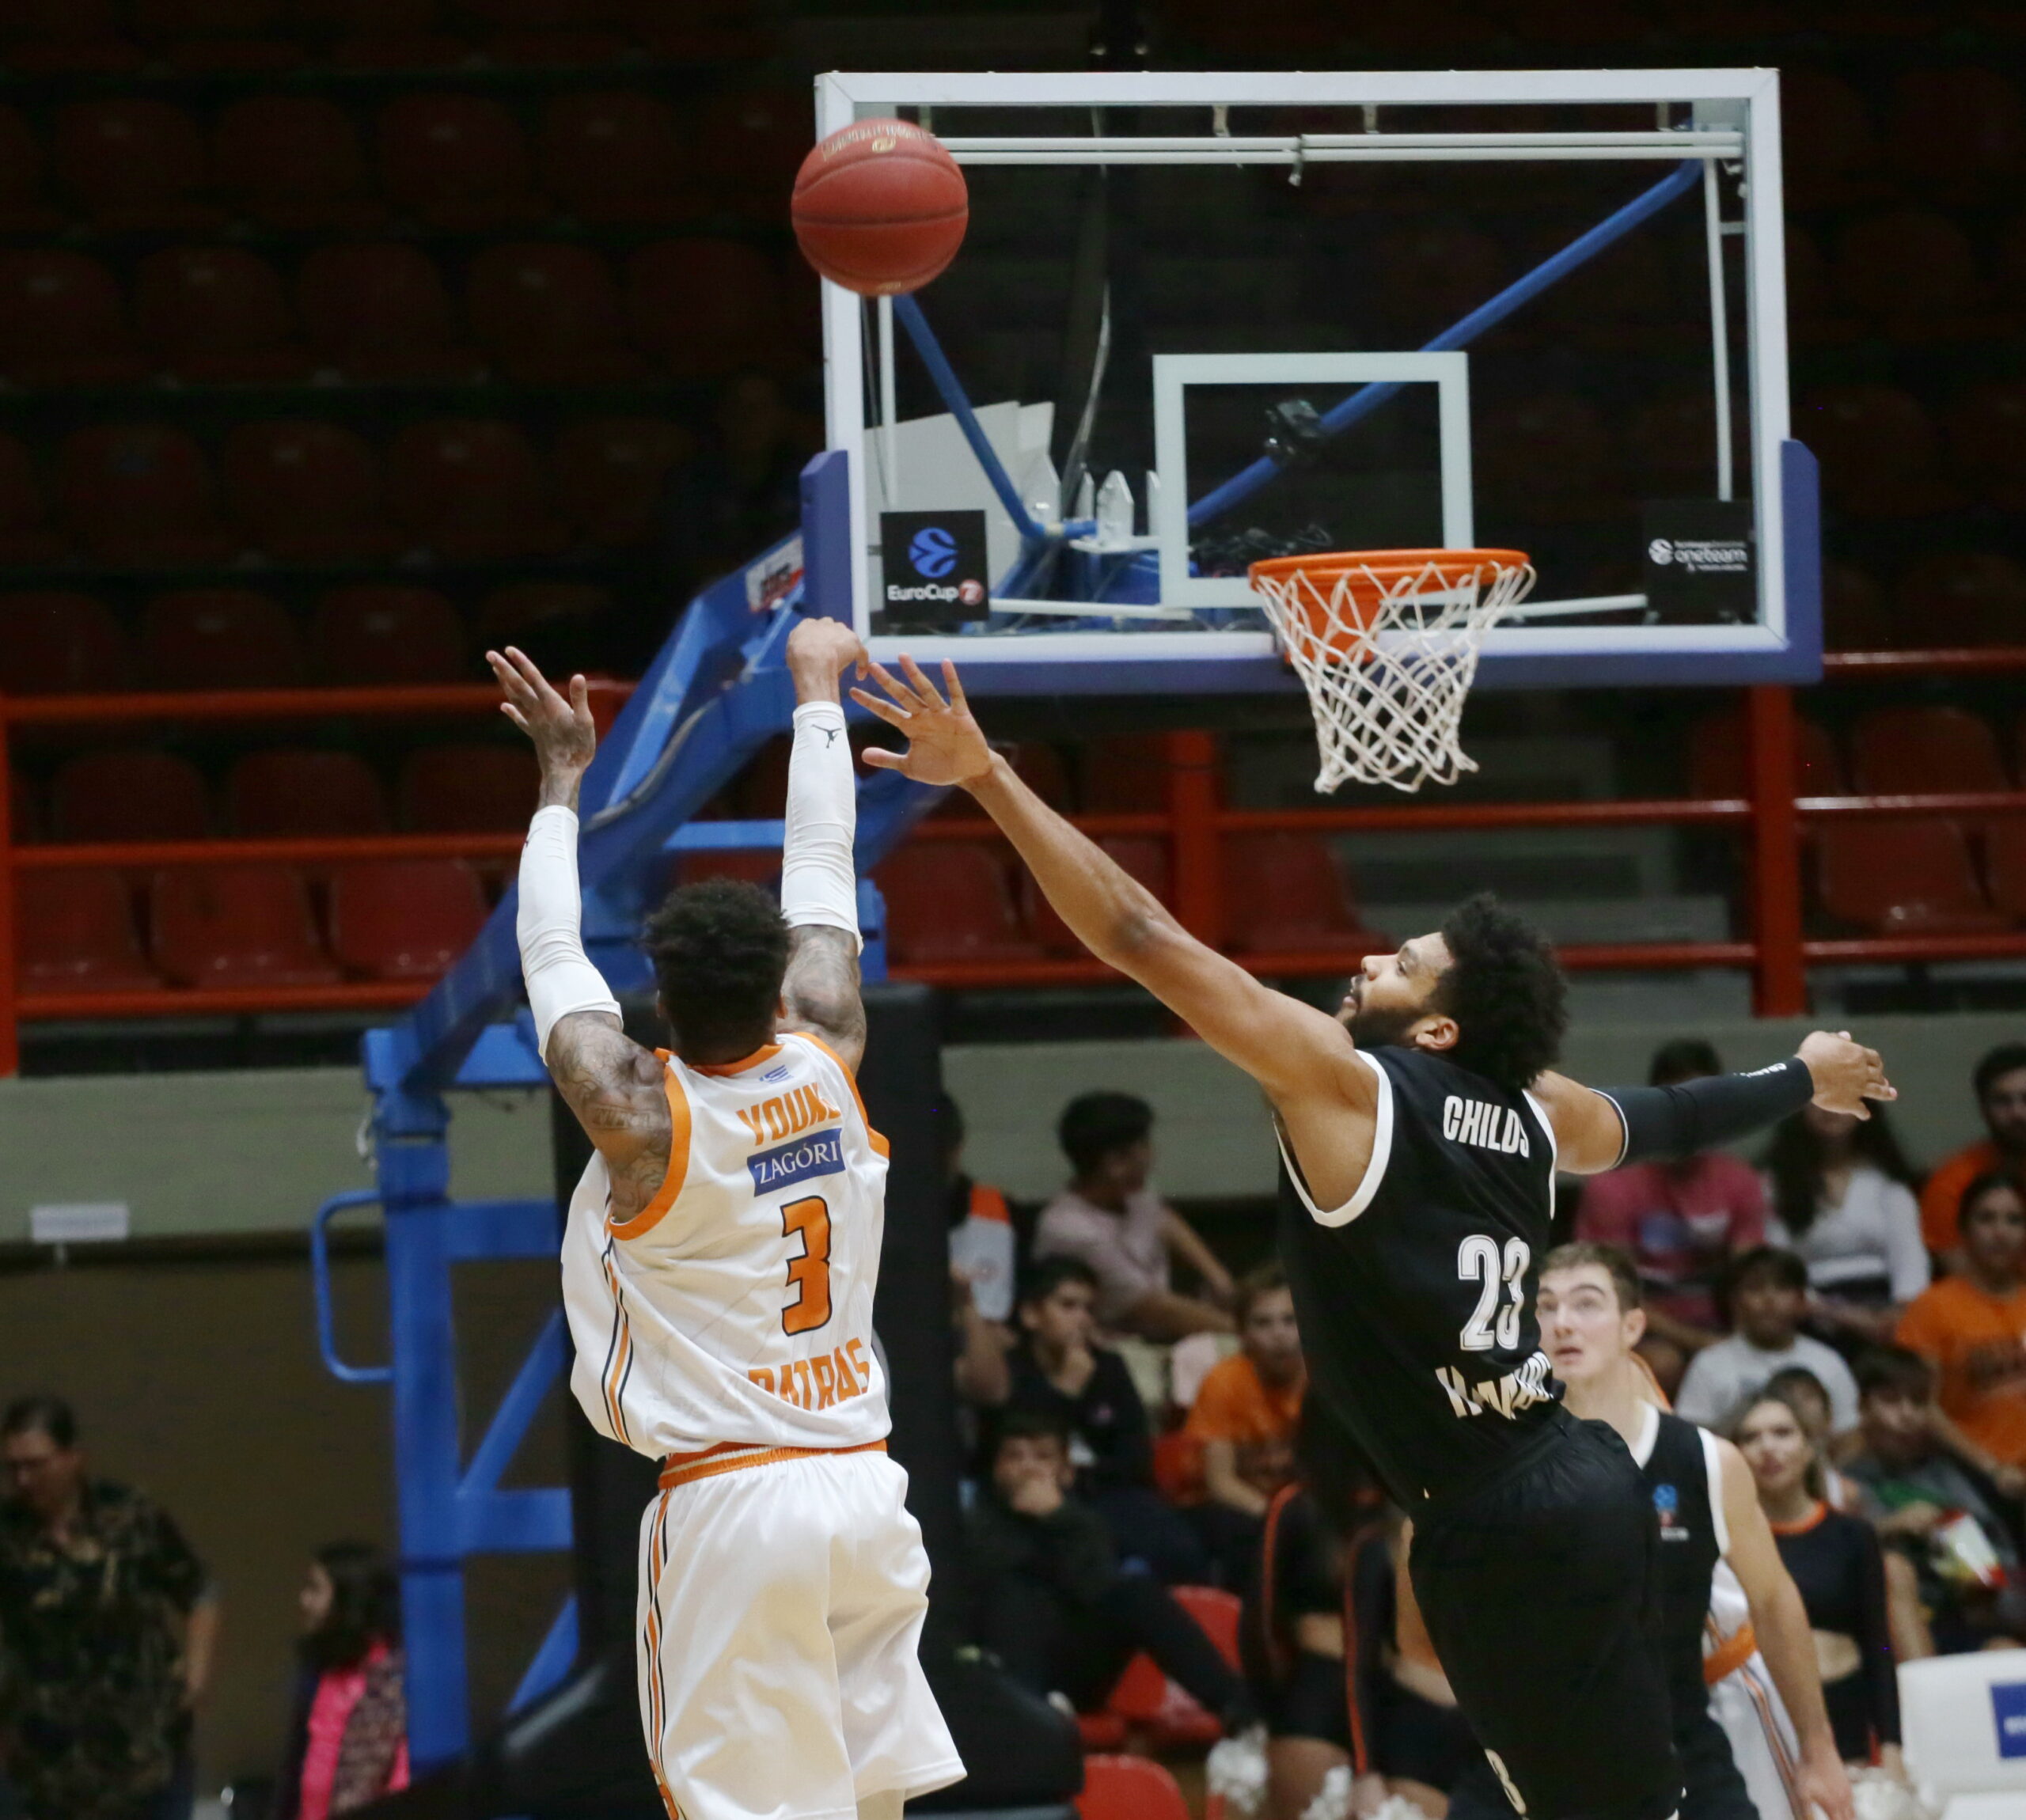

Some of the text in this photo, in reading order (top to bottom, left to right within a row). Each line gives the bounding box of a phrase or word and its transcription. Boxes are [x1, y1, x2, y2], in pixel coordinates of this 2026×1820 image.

[887, 583, 959, 603] EuroCup
[754, 1140, 839, 1185] ZAGÓRI
[780, 1195, 832, 1337] 3
[1457, 1234, 1531, 1351] 23
